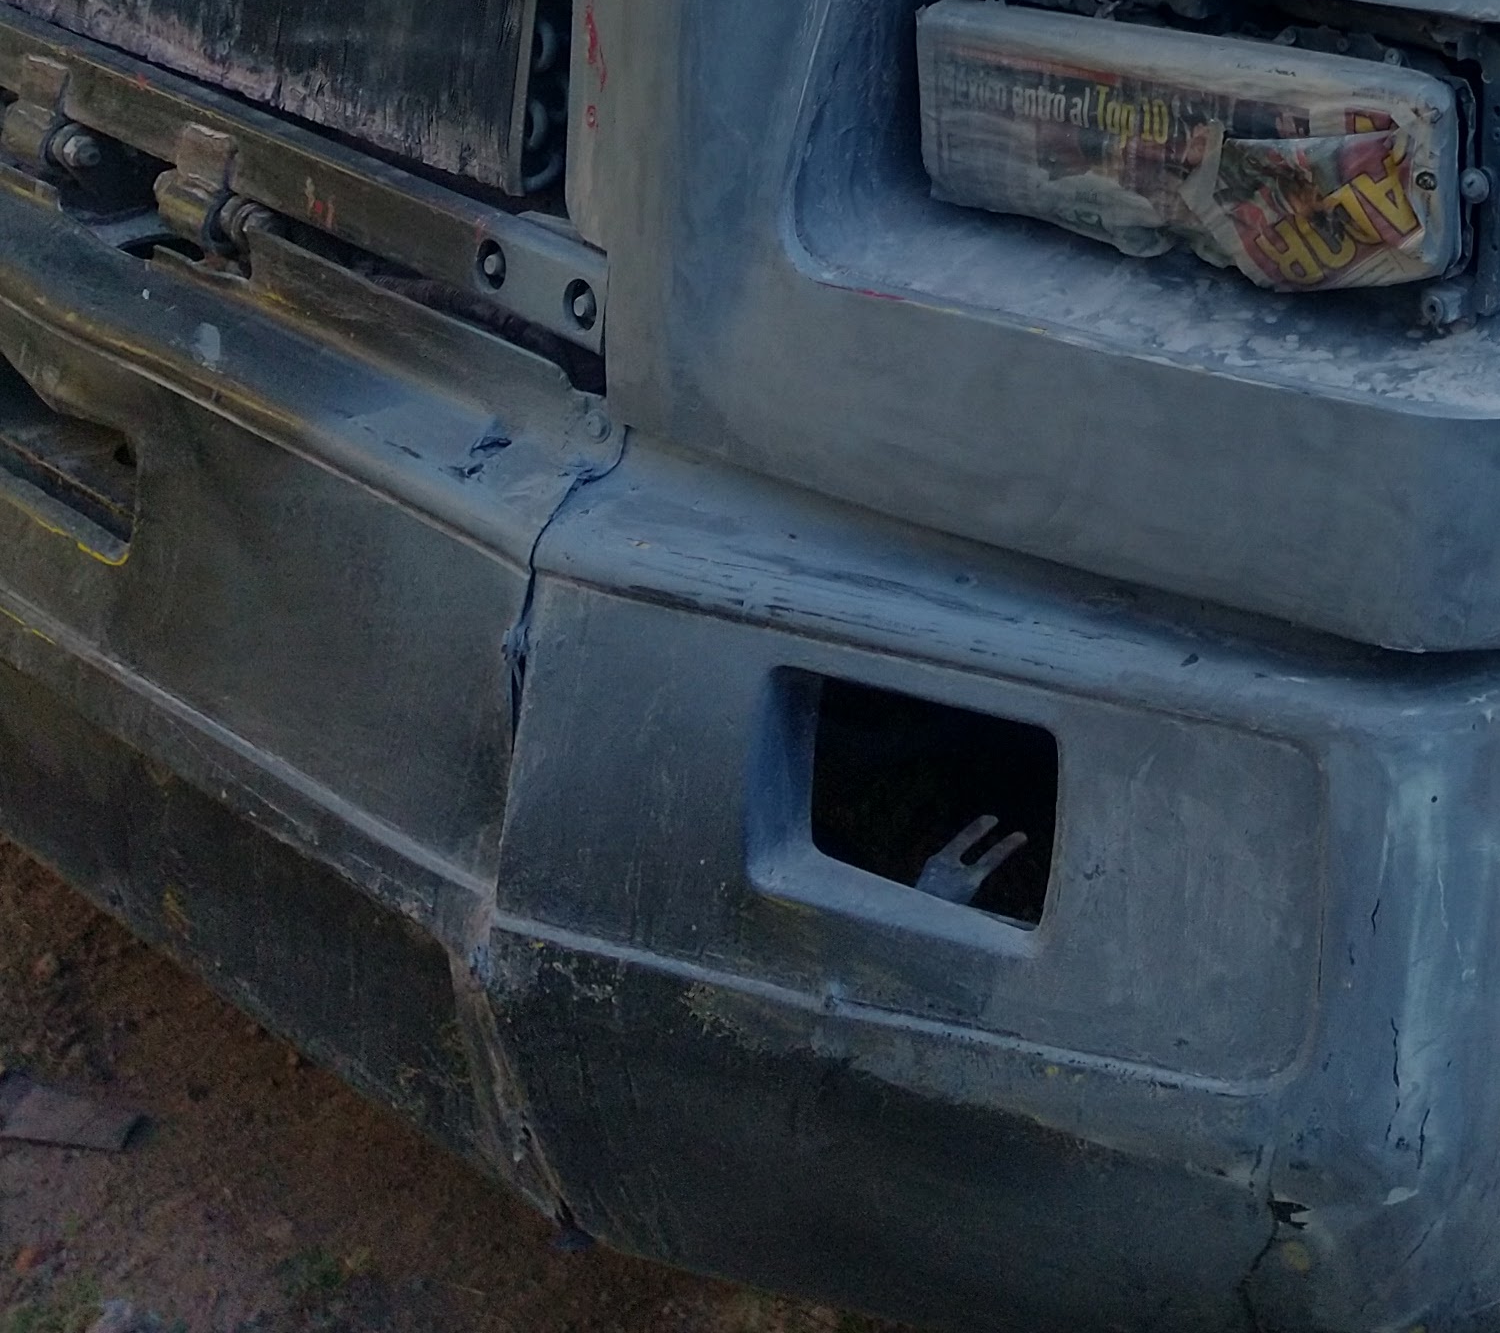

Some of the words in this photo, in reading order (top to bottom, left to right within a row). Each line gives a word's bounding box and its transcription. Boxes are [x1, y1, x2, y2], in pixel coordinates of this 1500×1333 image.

[1012, 85, 1066, 123] entró
[1069, 87, 1091, 129] al
[1096, 85, 1138, 149] Top
[1142, 96, 1170, 145] 10
